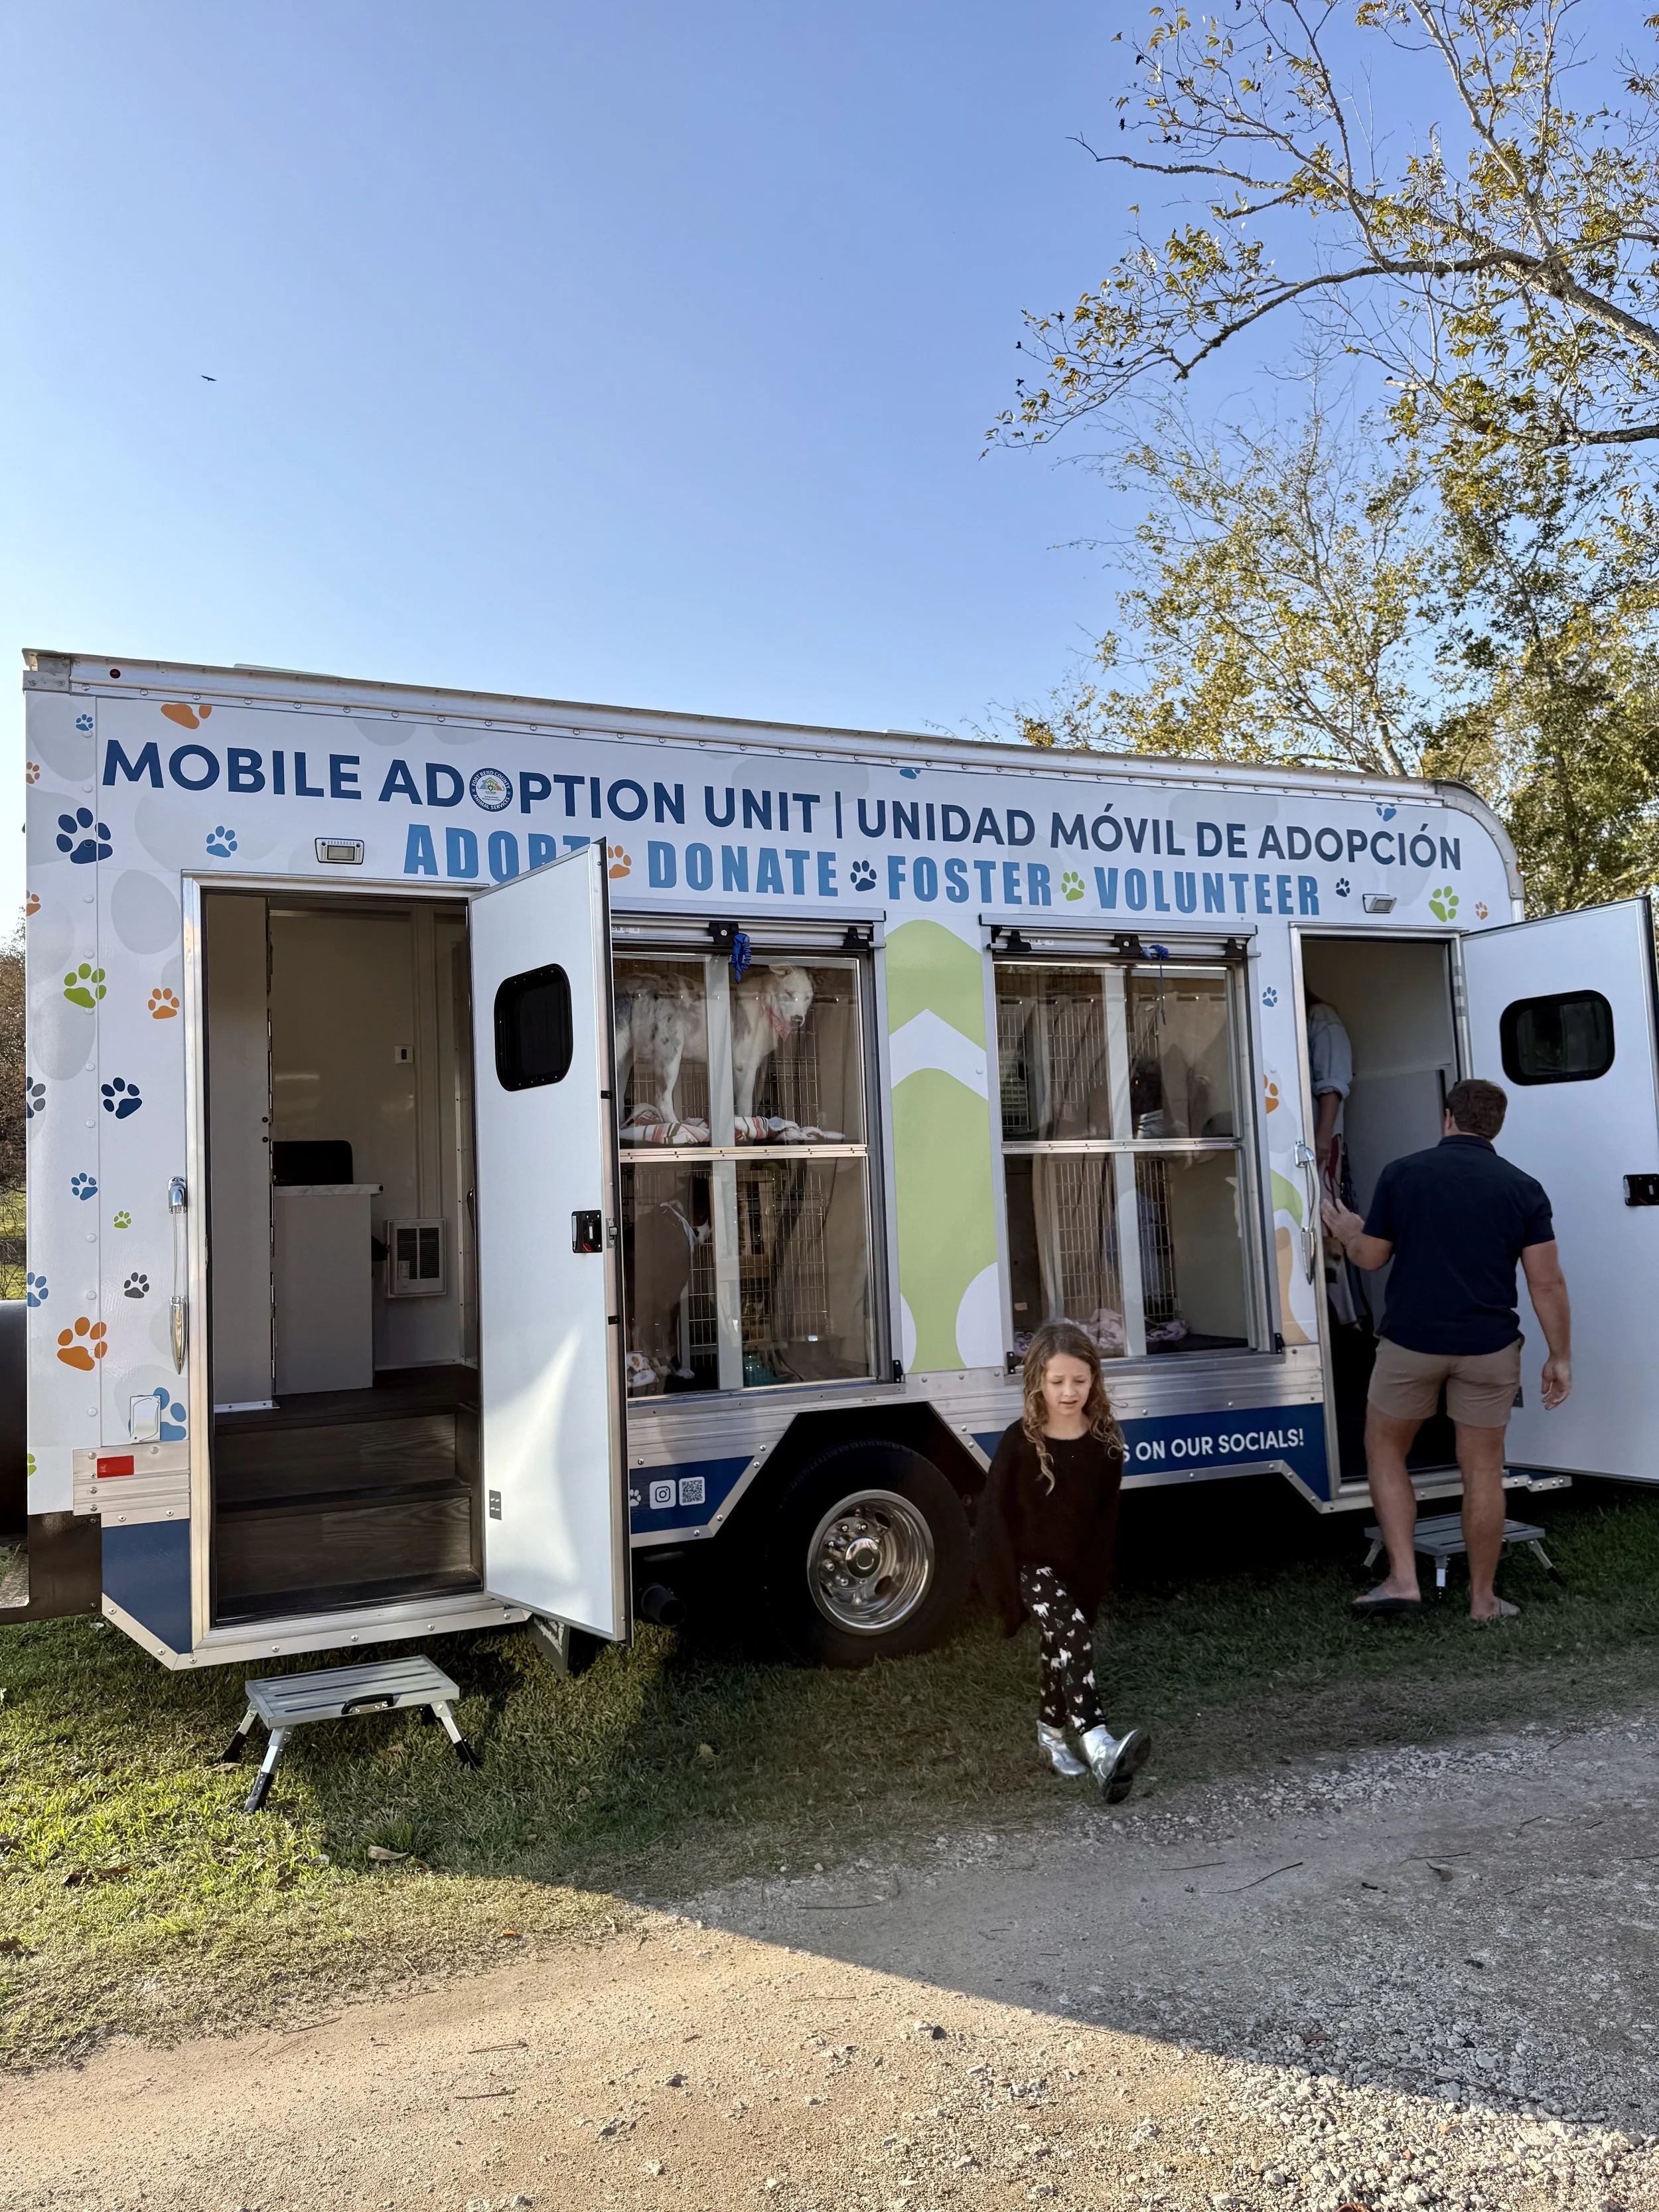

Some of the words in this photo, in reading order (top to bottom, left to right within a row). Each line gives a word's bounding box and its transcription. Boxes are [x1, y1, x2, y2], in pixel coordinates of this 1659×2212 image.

[472, 774, 480, 786] FORT
[494, 772, 510, 789] COUNTY
[102, 739, 362, 800] MOBILE
[704, 786, 821, 834] UNIT
[857, 798, 1035, 846] UNIDAD
[1050, 803, 1186, 856] MÓVIL
[1198, 821, 1249, 858] DE
[1258, 823, 1462, 871] ADOPCIÓN
[473, 794, 490, 810] ANIMAL
[490, 796, 510, 810] SERVICES
[647, 840, 838, 897] DONATE
[887, 855, 1052, 906] FOSTER
[1095, 866, 1319, 915] VOLUNTEER
[1135, 1439, 1165, 1461] ON
[1171, 1436, 1213, 1458] OUR
[1218, 1428, 1305, 1453] SOCIALS!
